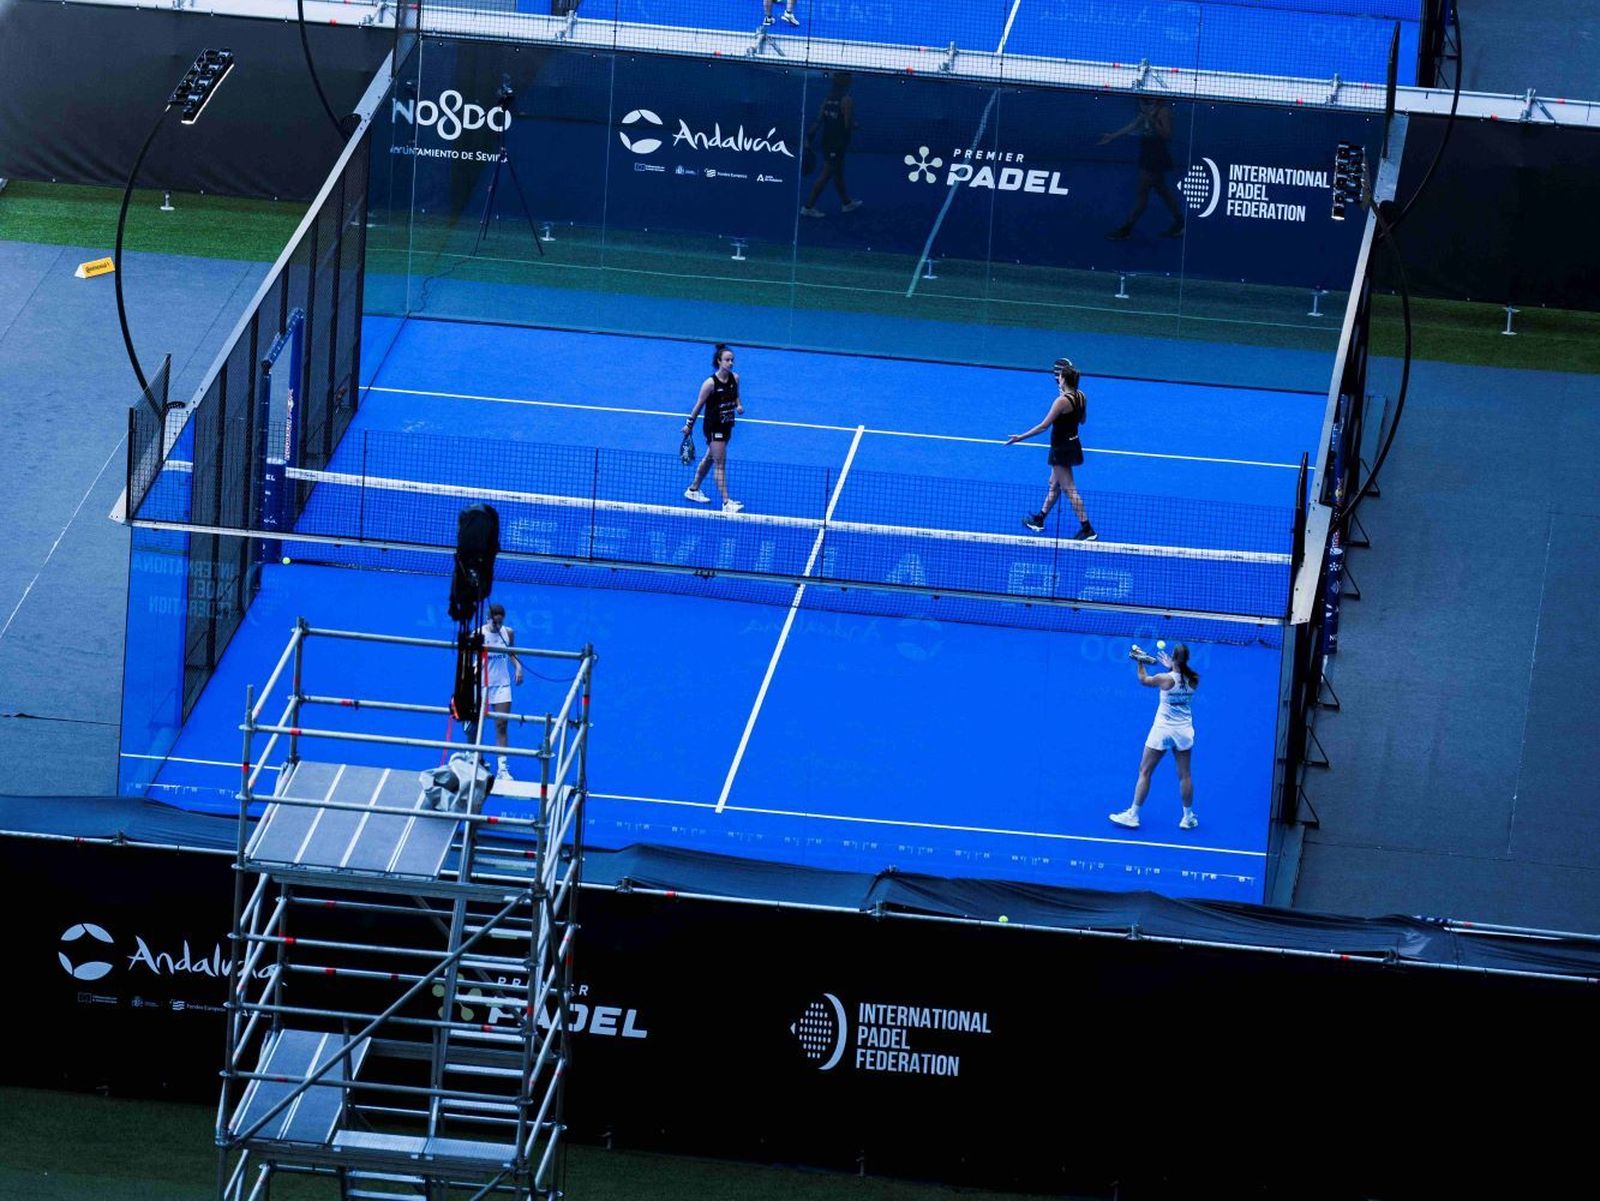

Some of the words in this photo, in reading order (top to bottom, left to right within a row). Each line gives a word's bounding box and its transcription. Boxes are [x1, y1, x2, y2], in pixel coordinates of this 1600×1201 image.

[673, 117, 796, 158] Andalucía
[461, 150, 474, 161] DE
[953, 147, 1025, 163] PREMIER
[946, 163, 1070, 195] PADEL
[1229, 163, 1331, 189] INTERNATIONAL
[1228, 181, 1270, 202] PADEL
[1226, 199, 1307, 223] FEDERATION
[859, 1002, 992, 1034] INTERNATIONAL
[857, 1025, 911, 1050] PADEL
[856, 1048, 960, 1077] FEDERATION
